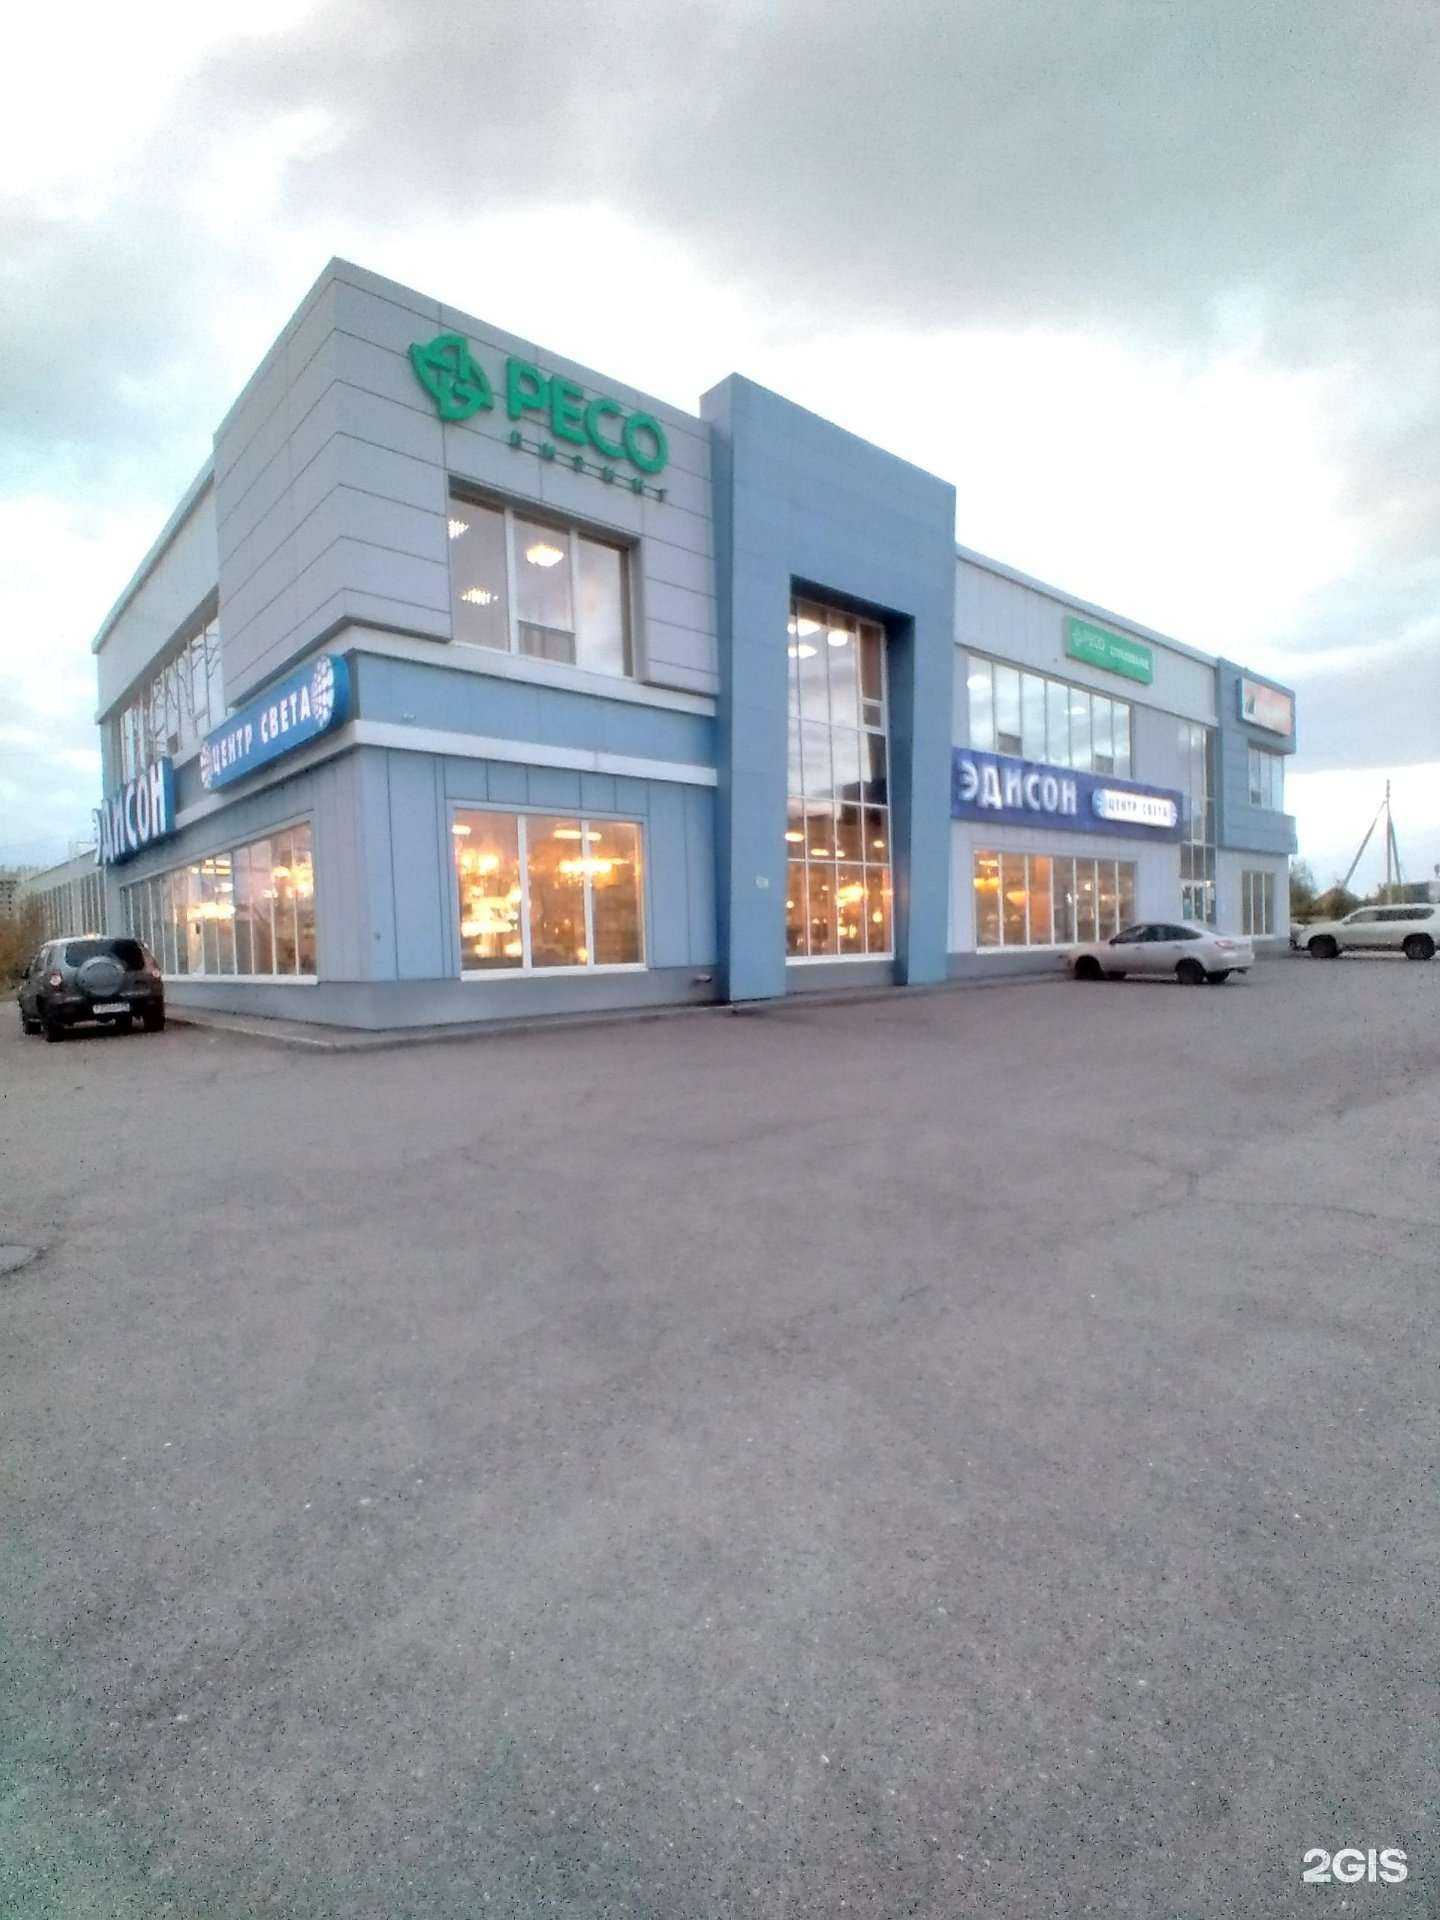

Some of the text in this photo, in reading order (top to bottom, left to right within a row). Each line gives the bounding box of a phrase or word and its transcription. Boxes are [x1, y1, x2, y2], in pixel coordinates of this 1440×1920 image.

[506, 357, 667, 474] РЕСО
[212, 686, 311, 776] ЦЕНТР СВЕТА
[959, 759, 1078, 815] ЭДИСОН
